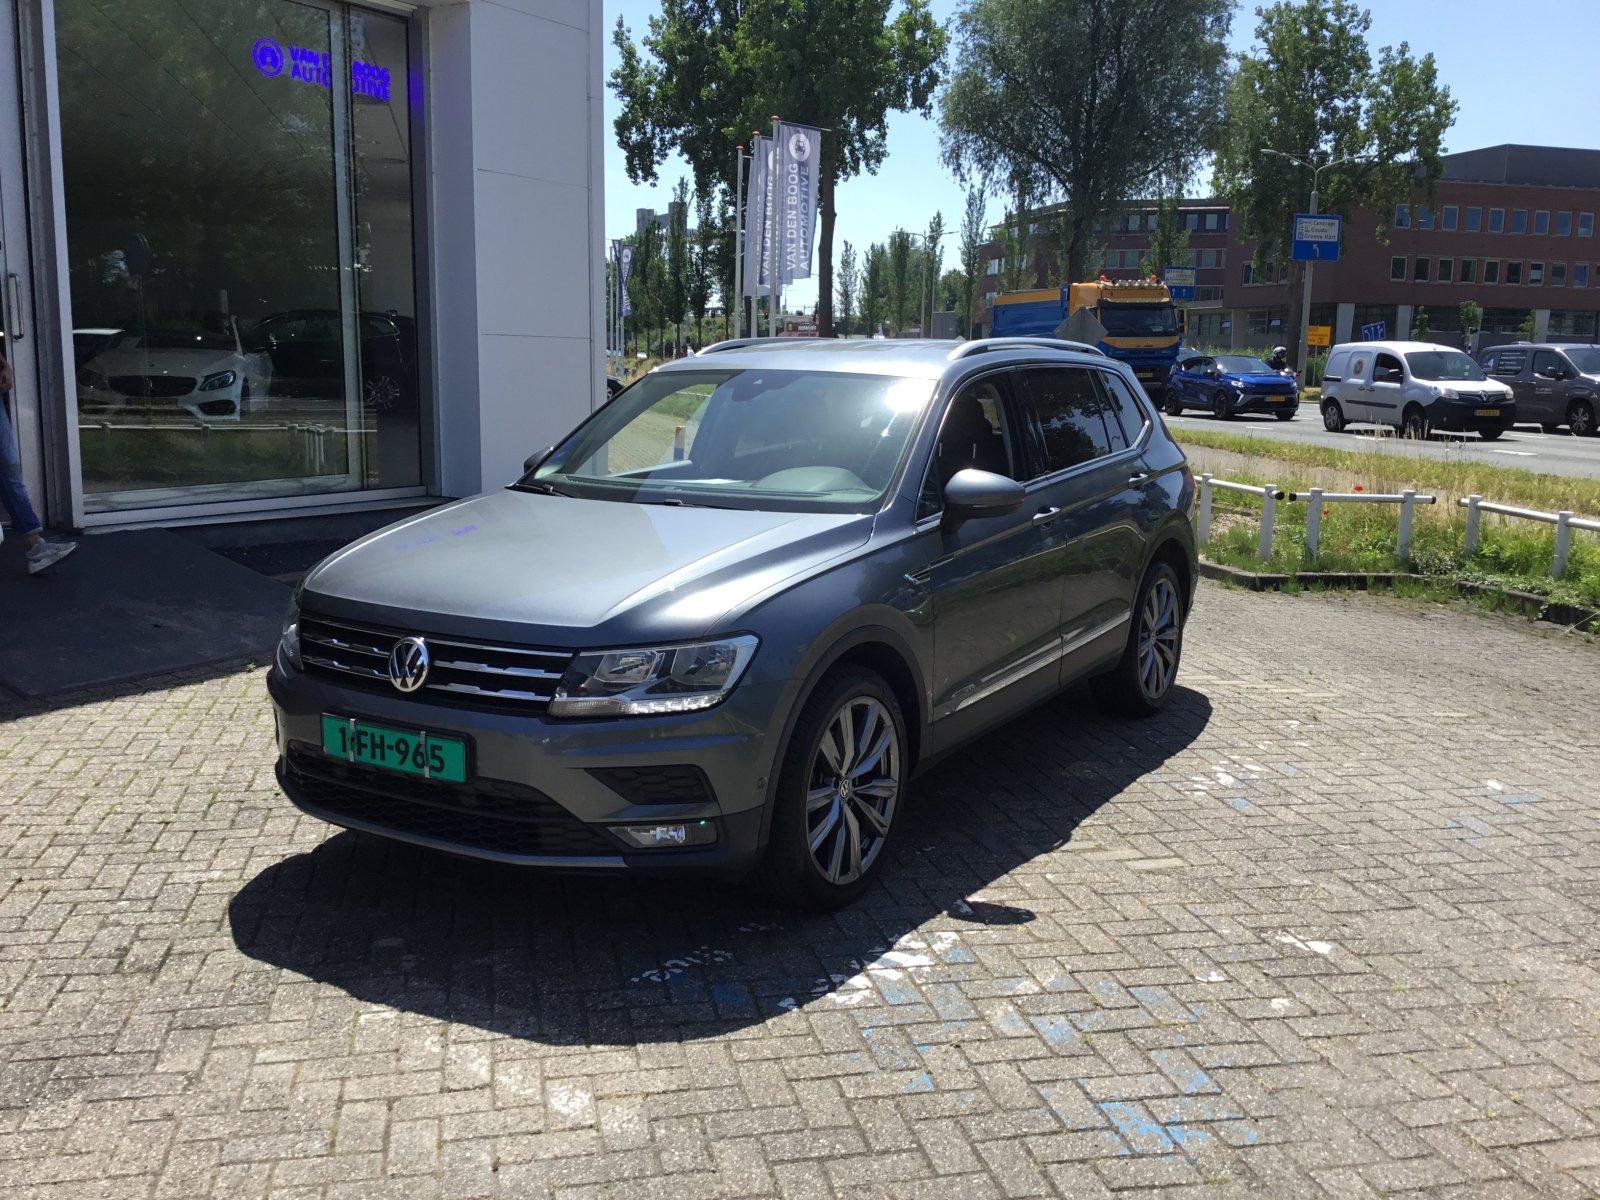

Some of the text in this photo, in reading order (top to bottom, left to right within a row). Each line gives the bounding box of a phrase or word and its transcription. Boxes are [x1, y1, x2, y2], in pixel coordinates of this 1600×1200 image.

[288, 44, 319, 66] VAN
[786, 162, 799, 271] VAN DEN BOOG
[799, 165, 809, 271] AUTOMOTIVE
[762, 220, 772, 247] DEN
[762, 250, 771, 277] VAN
